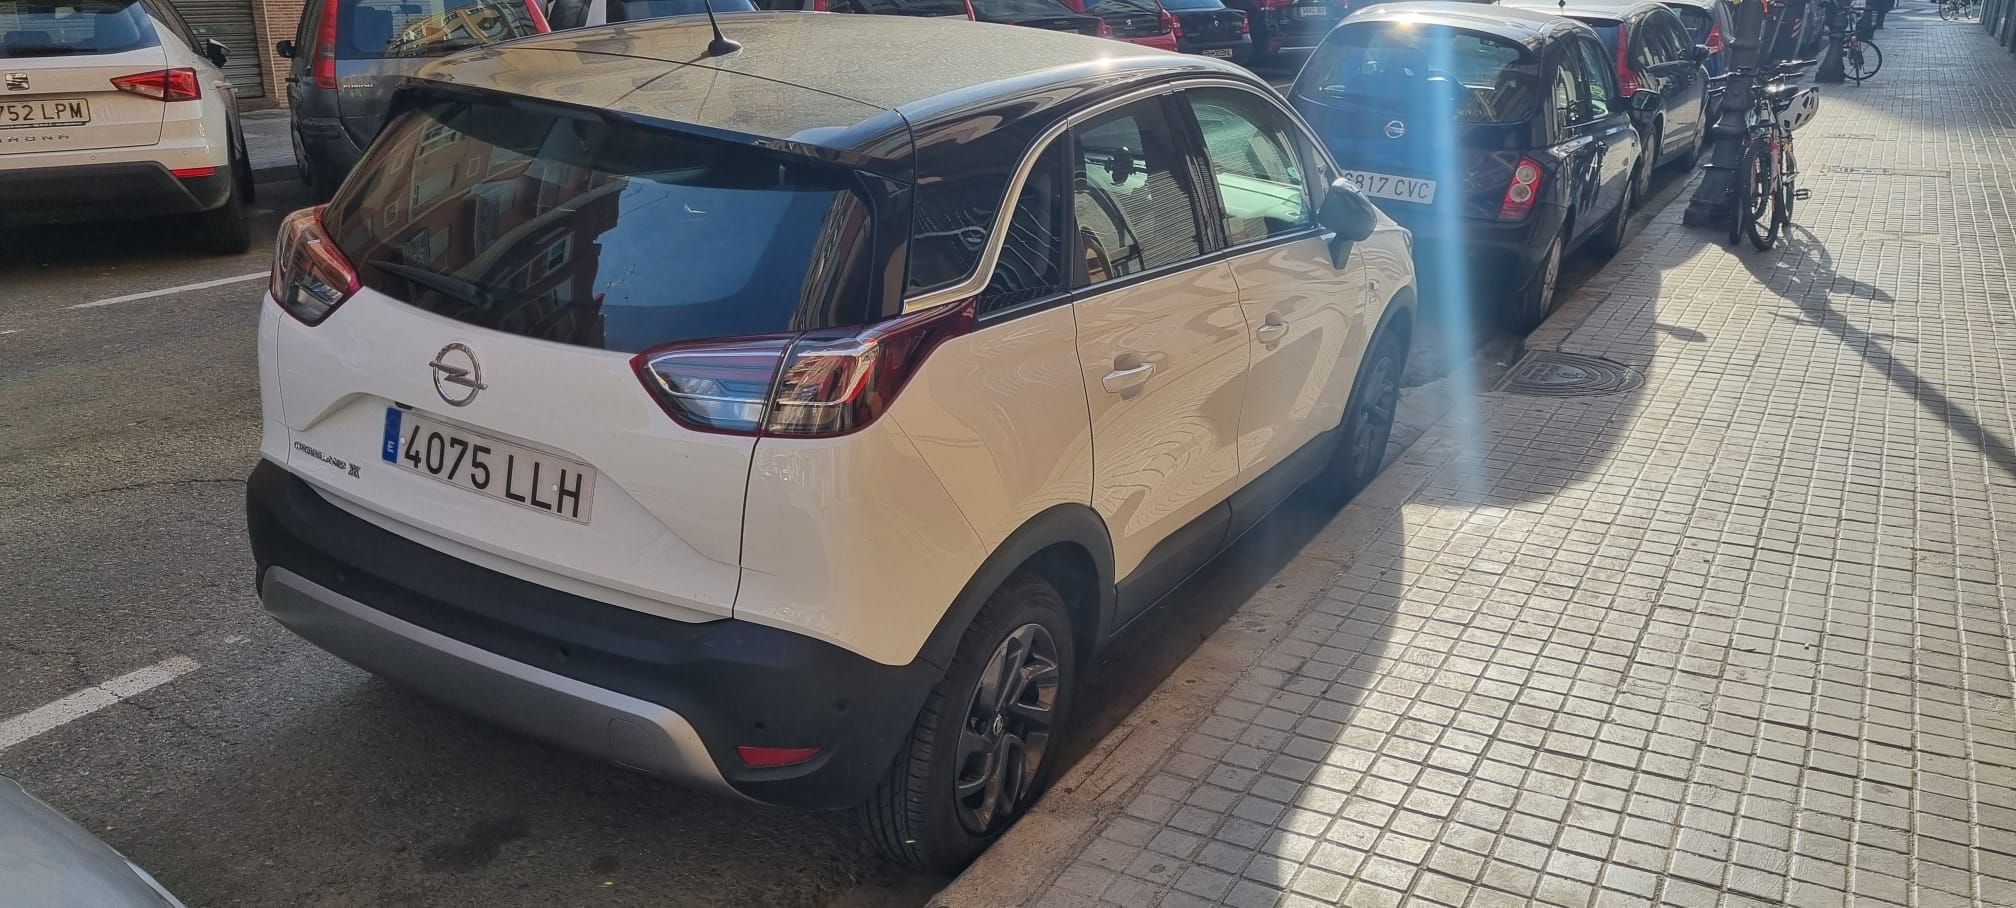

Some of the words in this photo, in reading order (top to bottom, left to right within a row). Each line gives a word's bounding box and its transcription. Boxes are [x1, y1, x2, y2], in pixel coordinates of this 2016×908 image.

[41, 102, 83, 119] LPM
[0, 134, 70, 143] RONA
[1394, 179, 1430, 199] CVC
[386, 440, 395, 453] E
[404, 425, 492, 490] 4075
[505, 454, 583, 518] LLH
